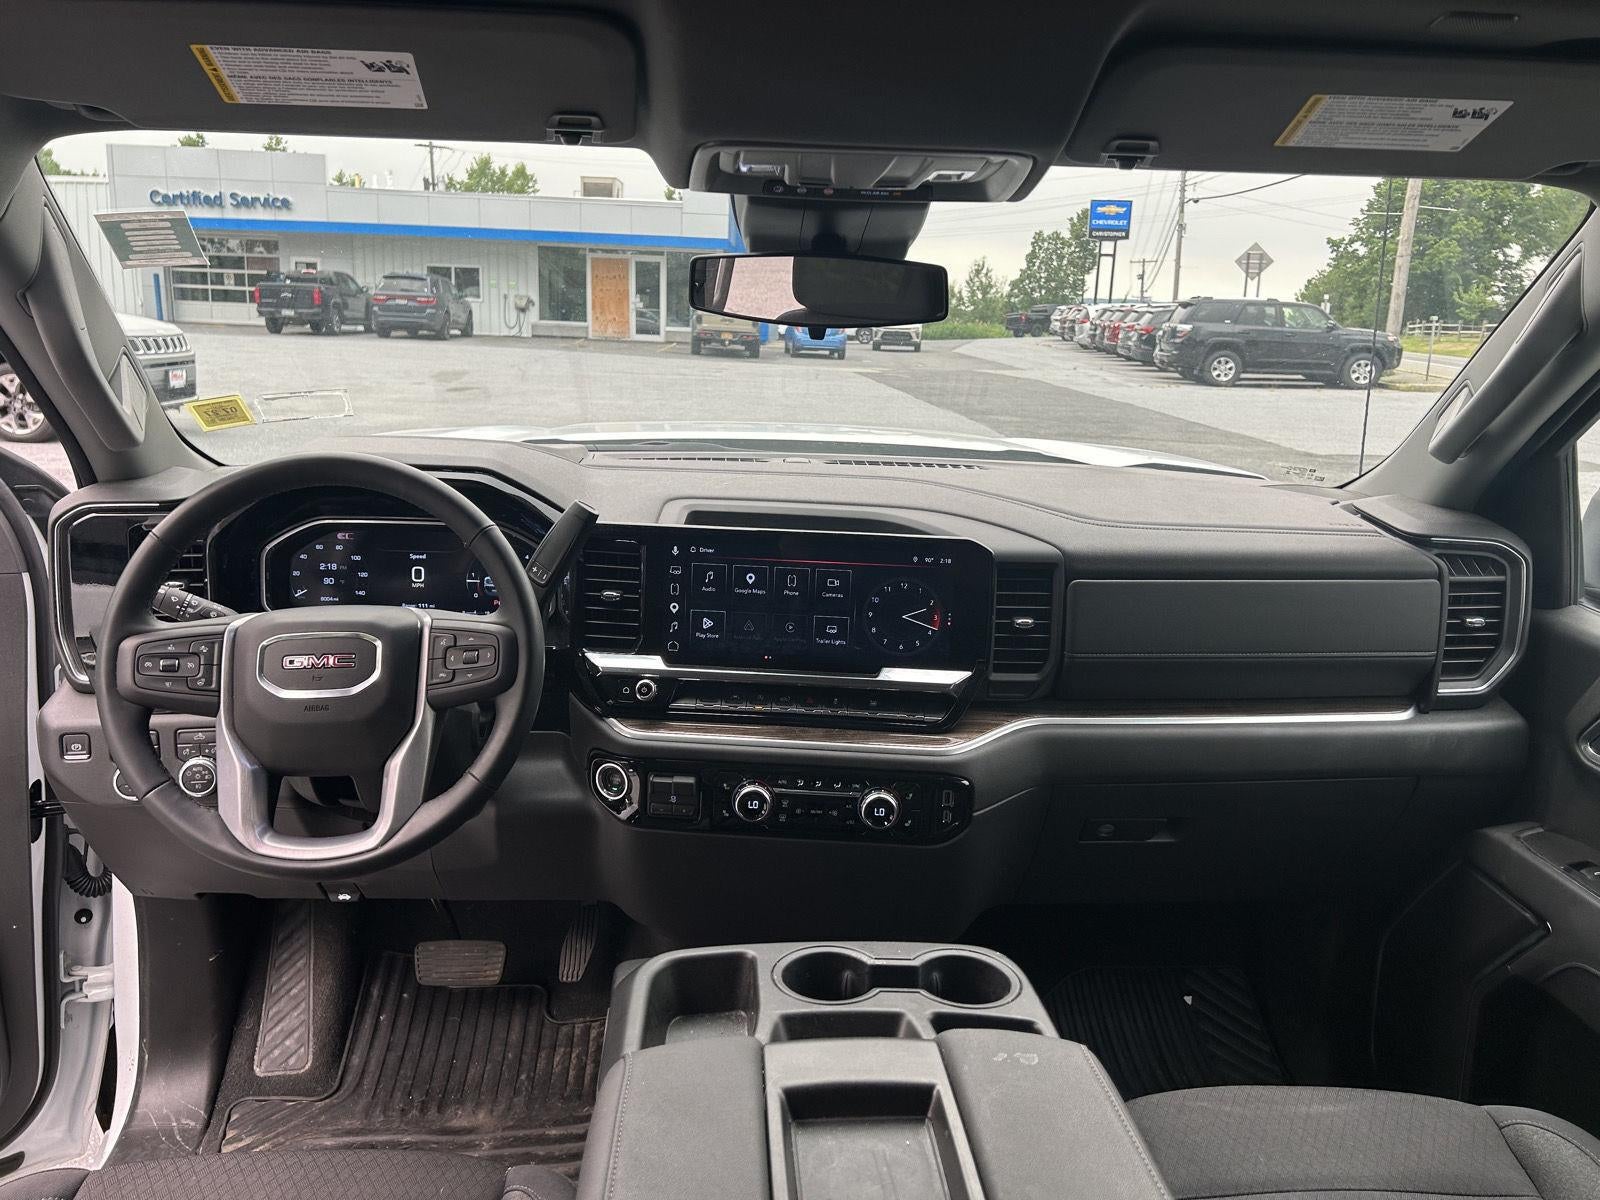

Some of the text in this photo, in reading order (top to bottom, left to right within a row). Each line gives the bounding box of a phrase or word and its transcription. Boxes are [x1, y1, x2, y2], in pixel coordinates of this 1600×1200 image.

[149, 189, 291, 209] Certified Service
[319, 563, 337, 571] 2:18
[411, 566, 425, 582] 0
[323, 577, 335, 585] 90
[900, 582, 908, 590] 12
[734, 587, 766, 596] Google Maps
[871, 596, 880, 604] 10
[831, 638, 846, 647] Lights
[915, 639, 920, 647] 5
[283, 654, 355, 669] GMC
[304, 704, 330, 713] AIRBAG
[747, 800, 759, 809] LO
[874, 807, 885, 816] LO
